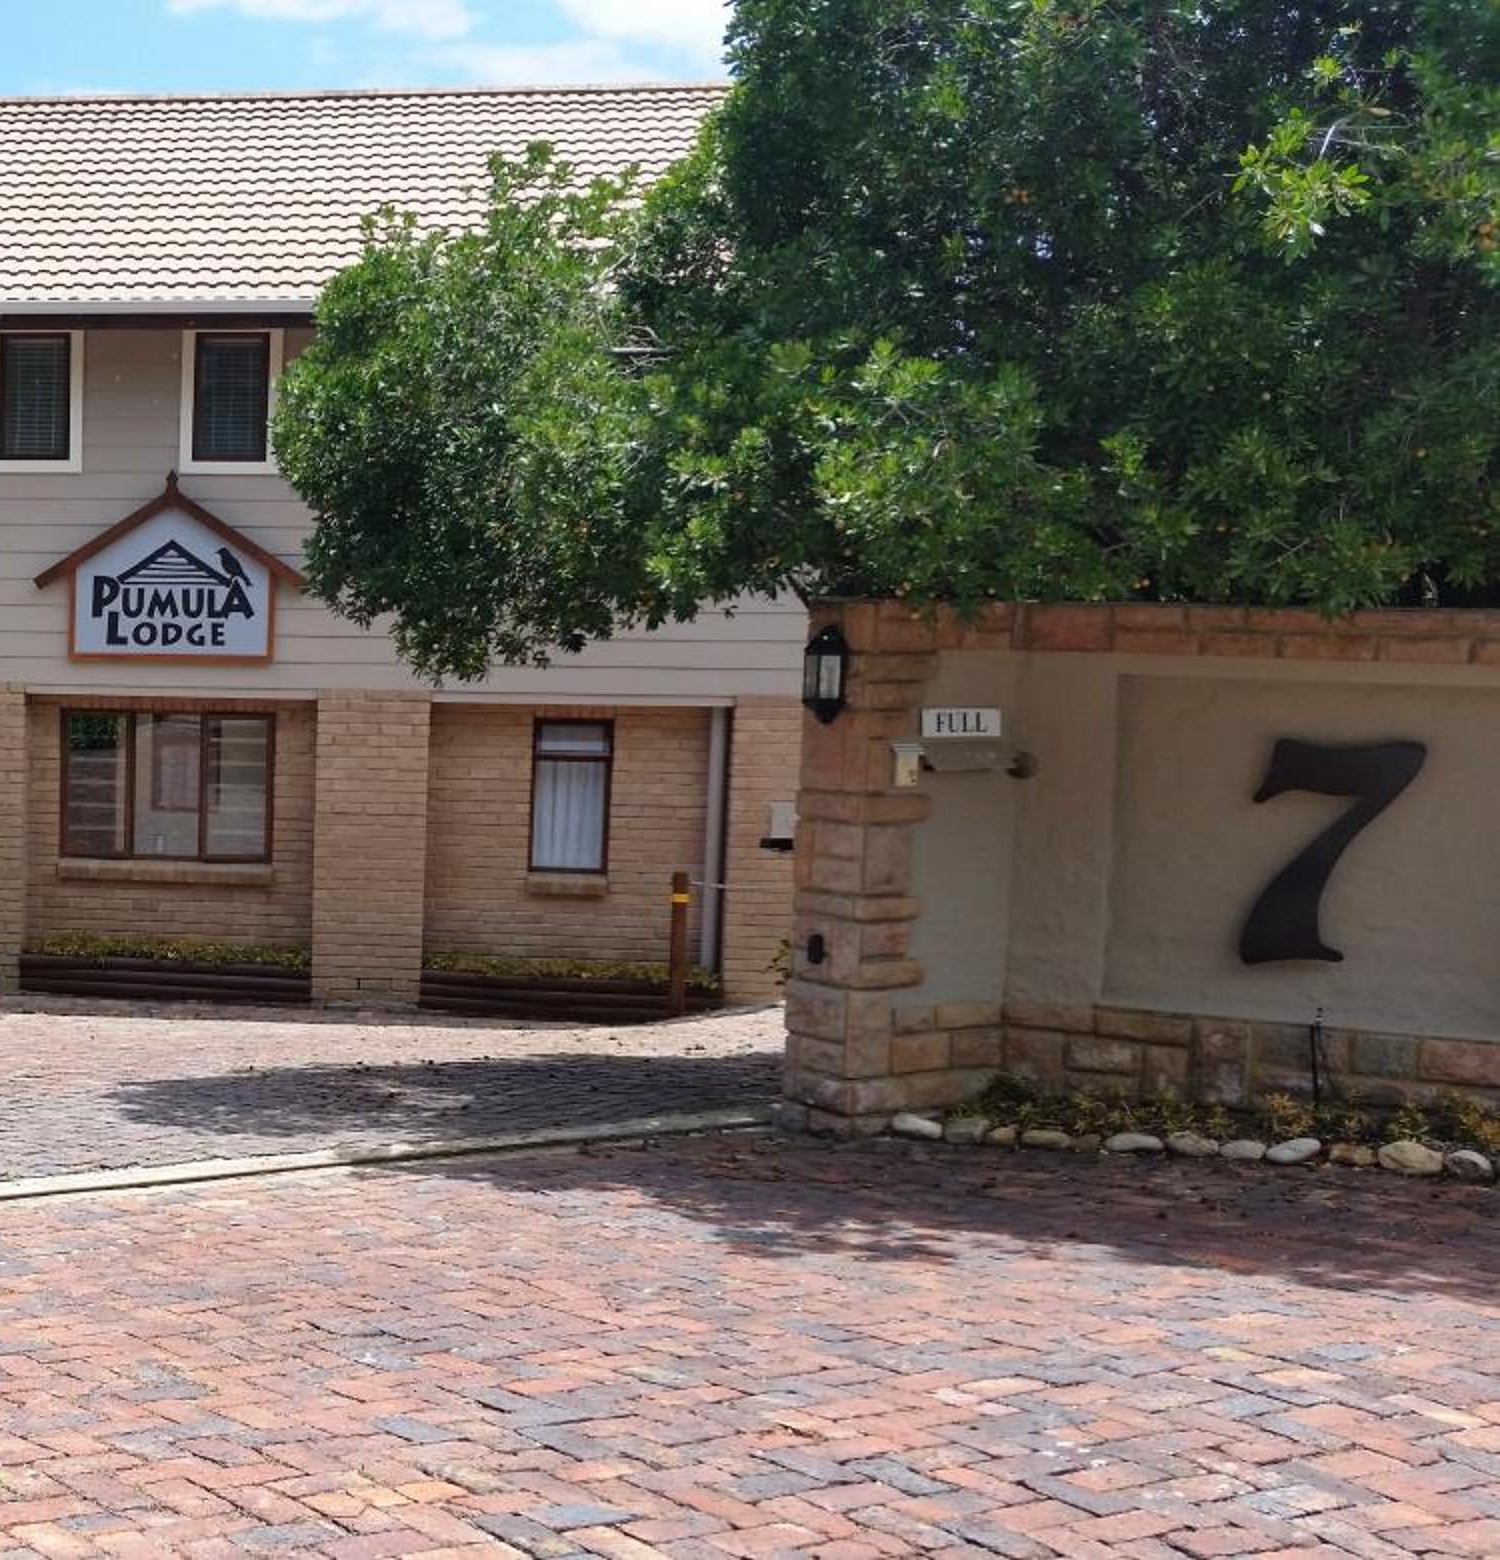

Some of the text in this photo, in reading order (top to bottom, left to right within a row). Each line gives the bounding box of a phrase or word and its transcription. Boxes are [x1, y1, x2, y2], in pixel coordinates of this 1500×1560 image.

[91, 575, 255, 619] PUMULA
[106, 611, 226, 647] LODGE
[935, 711, 988, 733] FULL
[1239, 737, 1427, 966] 7
